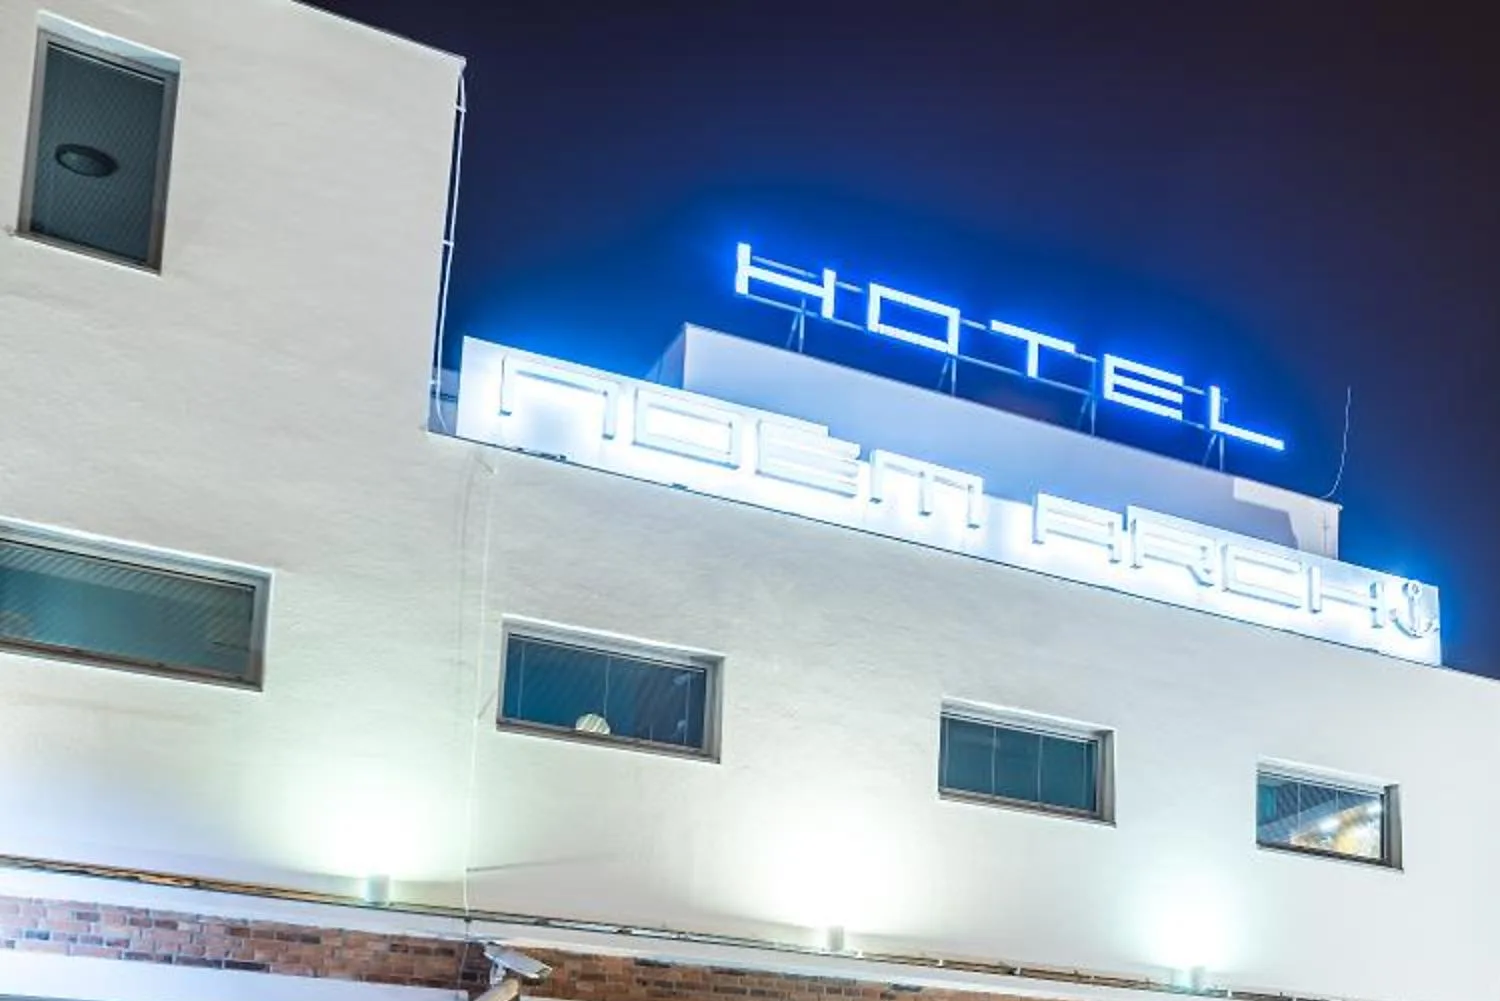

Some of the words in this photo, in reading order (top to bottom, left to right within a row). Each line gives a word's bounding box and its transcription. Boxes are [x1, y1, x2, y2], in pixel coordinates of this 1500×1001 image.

[734, 242, 1285, 452] HOTEL
[499, 352, 984, 529] NOEM
[1032, 491, 1385, 629] ARCH
